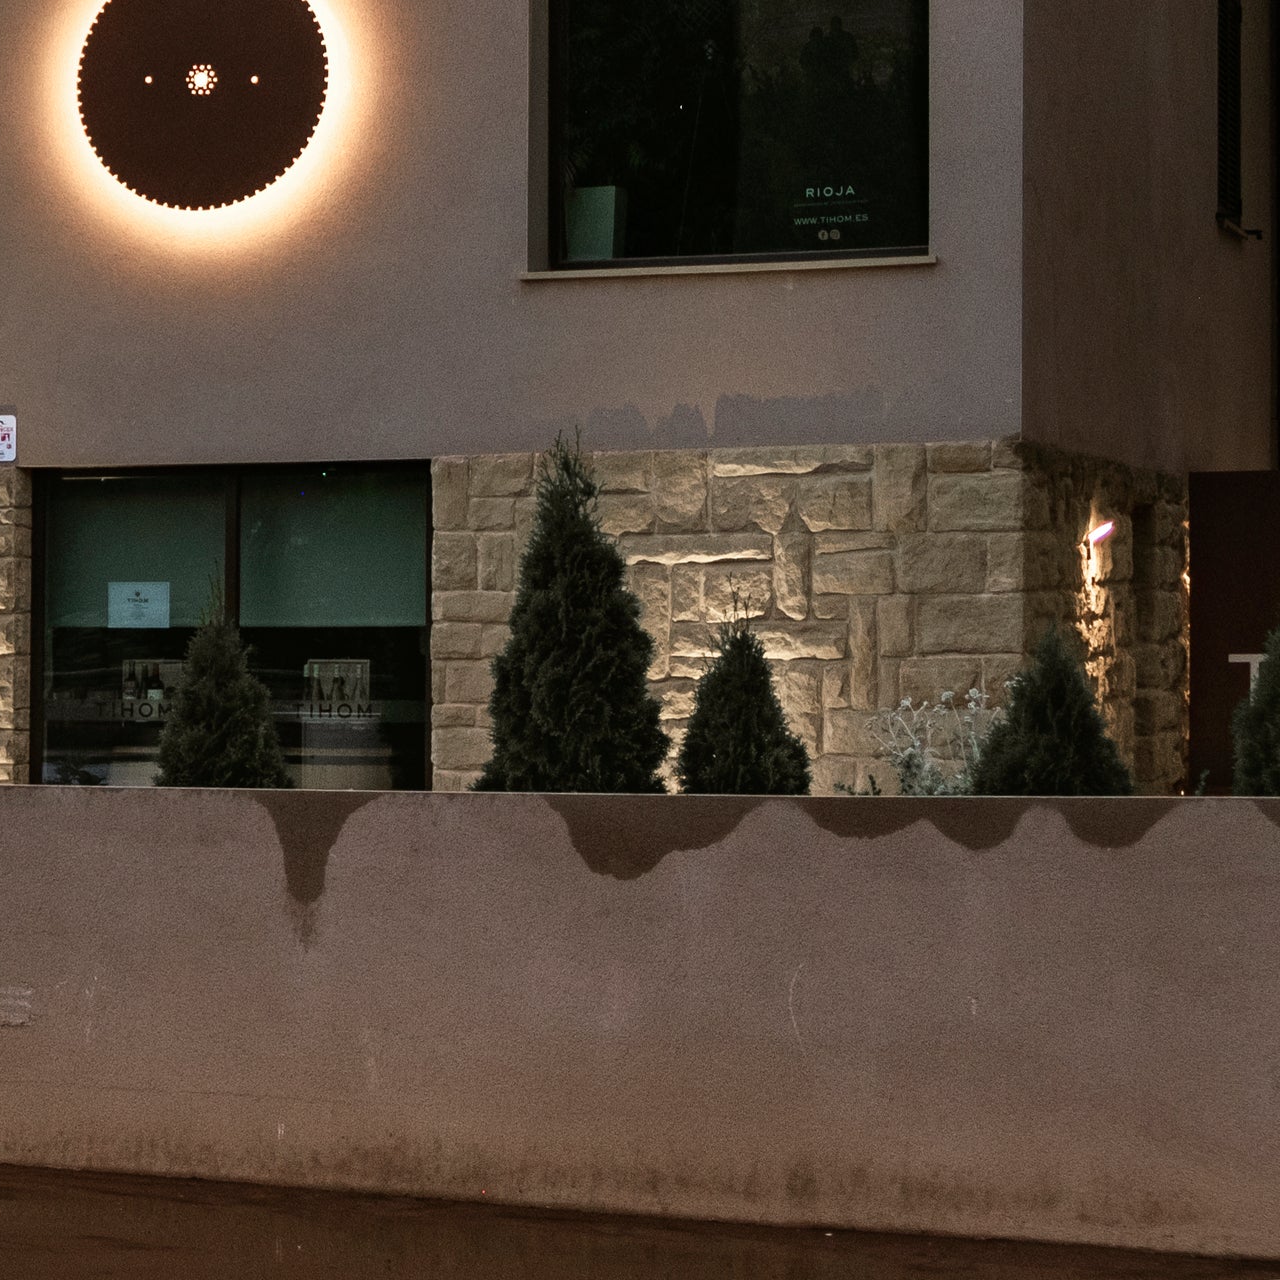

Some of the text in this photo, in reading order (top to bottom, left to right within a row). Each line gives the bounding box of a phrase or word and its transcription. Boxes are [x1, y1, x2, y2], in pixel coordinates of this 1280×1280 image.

[805, 184, 856, 199] RIOJA
[96, 702, 172, 718] TIHOM
[295, 702, 373, 718] TIHOM
